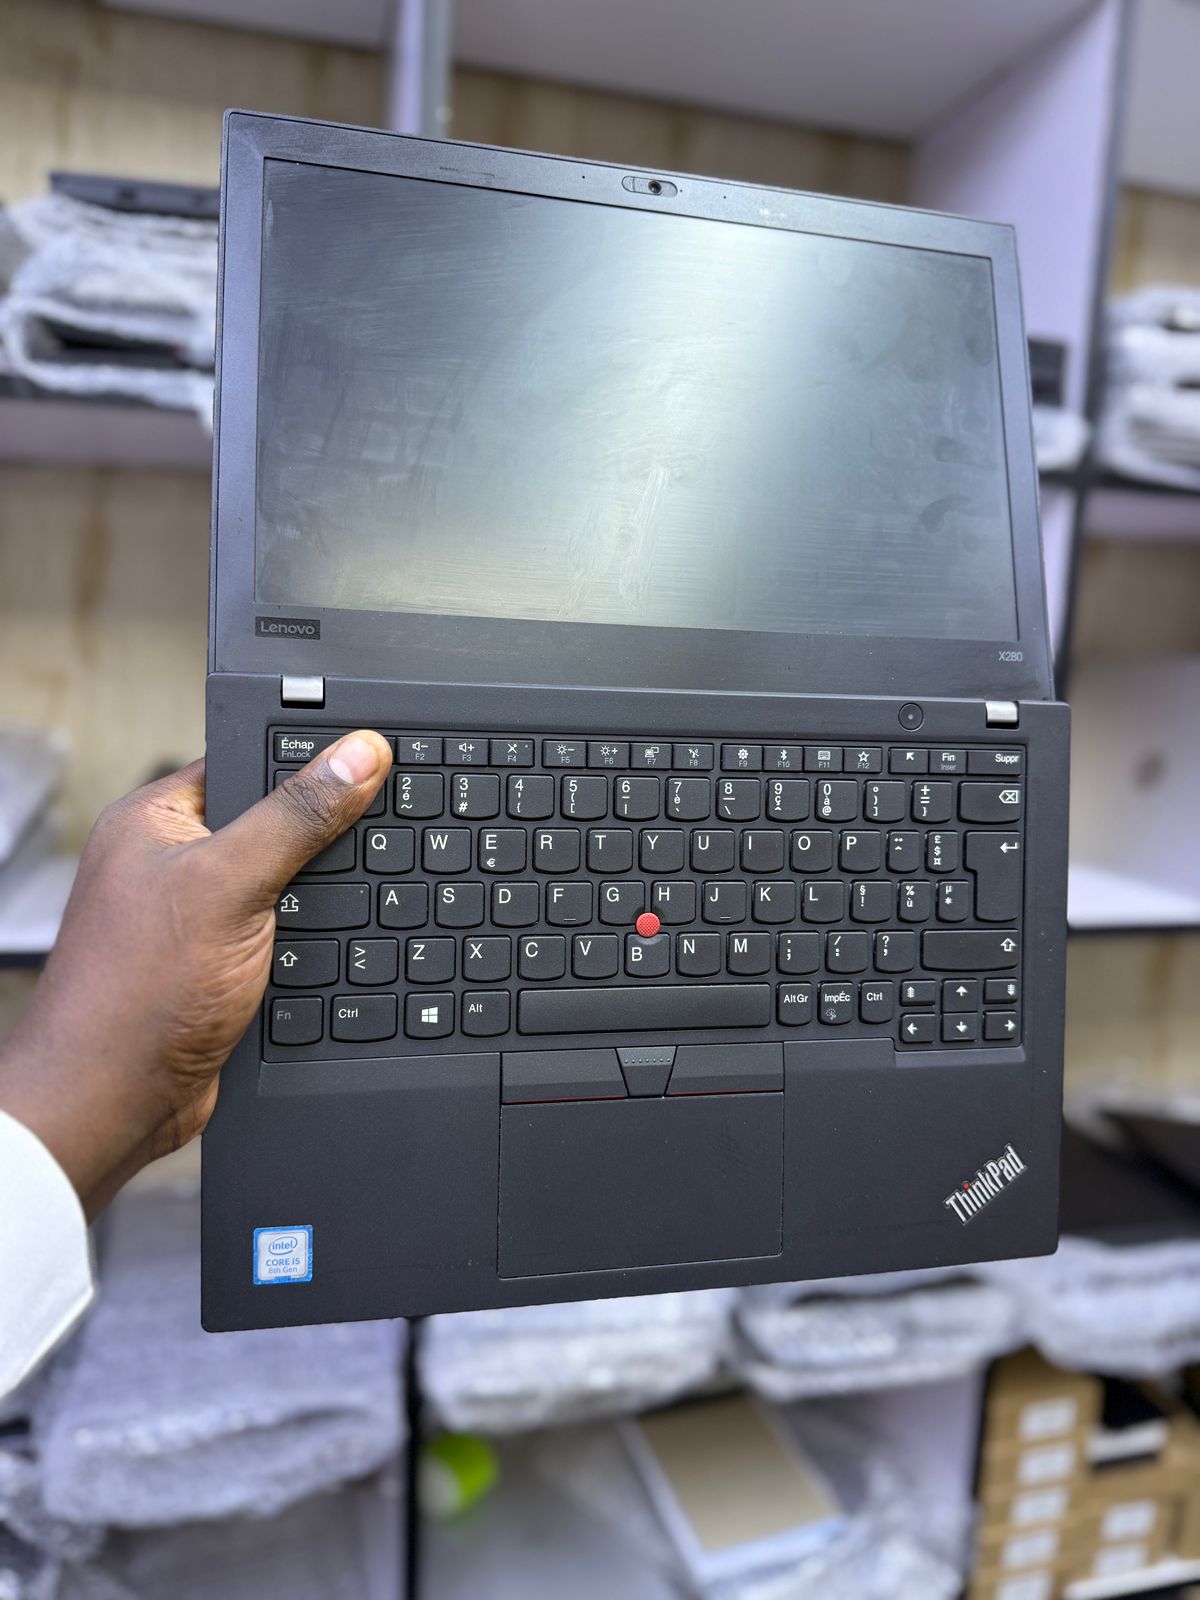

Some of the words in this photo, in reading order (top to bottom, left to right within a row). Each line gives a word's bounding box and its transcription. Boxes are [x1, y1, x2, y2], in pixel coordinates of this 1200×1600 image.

[260, 620, 315, 634] Lenovo
[998, 651, 1022, 662] X280
[281, 737, 314, 750] Échap
[995, 754, 1019, 764] Suppr
[402, 778, 411, 789] 2
[459, 778, 468, 790] 3
[515, 779, 523, 791] 4
[570, 780, 577, 791] 5
[622, 781, 630, 792] 6
[674, 782, 681, 793] 7
[725, 783, 732, 794] 8
[775, 783, 782, 794] 9
[824, 784, 831, 795] 0
[403, 790, 409, 800] é
[571, 793, 574, 802] (
[674, 794, 680, 803] è
[775, 796, 781, 805] ç
[824, 796, 830, 805] à
[459, 802, 468, 812] #
[517, 803, 520, 812] {
[571, 803, 575, 813] [
[823, 806, 831, 815] @
[874, 807, 877, 816] ]
[372, 834, 386, 850] Q
[430, 835, 448, 850] W
[486, 835, 497, 850] E
[541, 835, 552, 849] R
[595, 835, 606, 849] T
[647, 836, 658, 849] Y
[698, 836, 709, 850] U
[798, 836, 810, 850] O
[847, 837, 856, 850] P
[487, 858, 495, 867] €
[443, 888, 454, 903] S
[499, 889, 511, 903] D
[554, 888, 564, 902] F
[607, 888, 619, 902] G
[659, 887, 669, 901] H
[710, 888, 718, 901] J
[761, 888, 770, 901] K
[810, 887, 818, 900] L
[906, 886, 914, 895] %
[385, 890, 398, 905] A
[907, 898, 913, 907] ù
[684, 939, 694, 953] N
[735, 939, 747, 952] M
[883, 936, 889, 947] ?
[413, 945, 425, 960] Z
[470, 944, 482, 958] X
[525, 942, 538, 957] C
[580, 941, 591, 955] V
[632, 947, 642, 961] B
[784, 994, 808, 1003] AltGr
[825, 991, 850, 1003] ImpÉc
[867, 993, 882, 1001] Ctrl
[338, 1009, 358, 1018] Ctrl
[469, 1004, 482, 1012] Alt
[277, 1011, 291, 1020] Fn
[946, 1146, 1024, 1222] ThinkPad
[272, 1240, 293, 1250] intel
[266, 1258, 290, 1266] CORE
